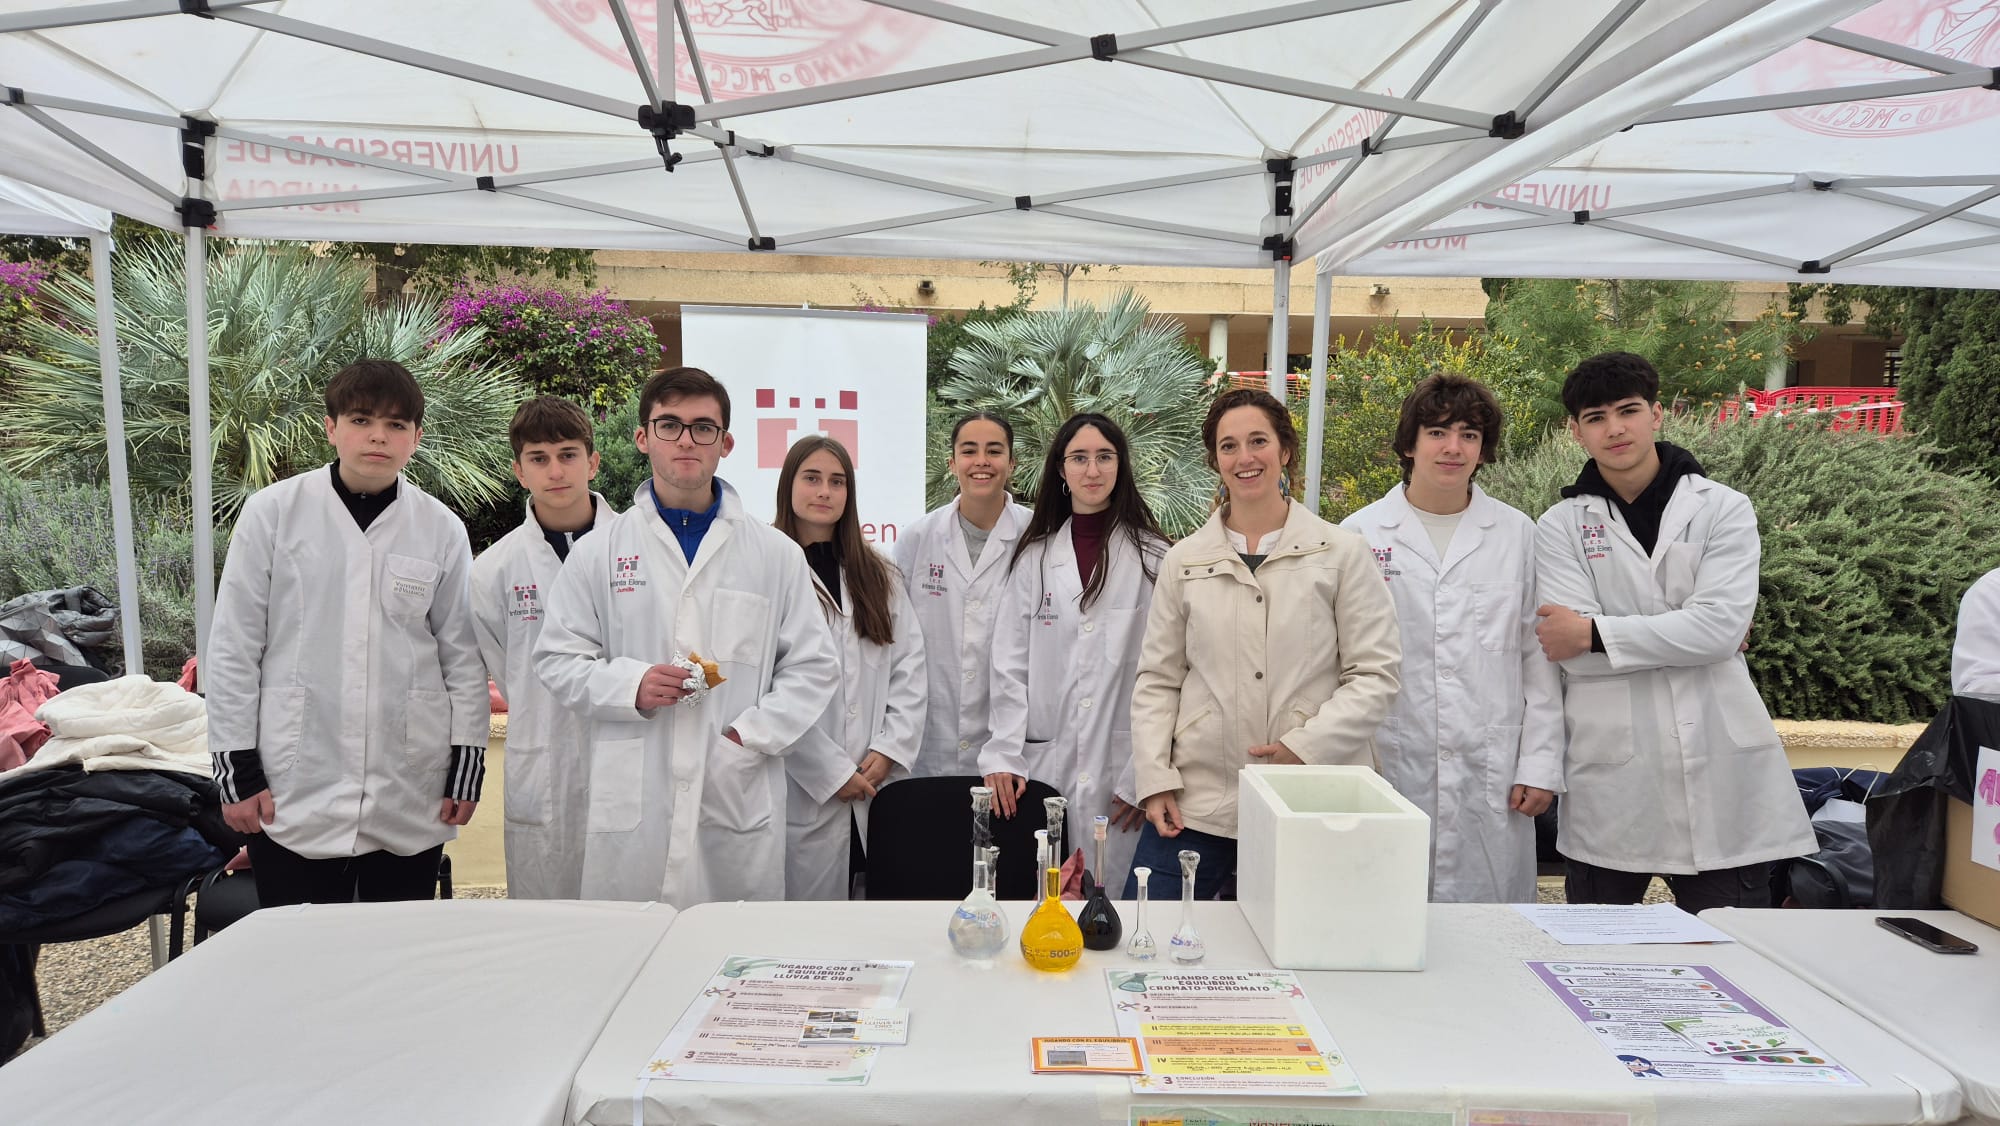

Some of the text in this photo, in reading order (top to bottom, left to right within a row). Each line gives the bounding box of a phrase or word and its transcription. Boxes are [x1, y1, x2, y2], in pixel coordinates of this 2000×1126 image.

[628, 578, 647, 586] Elena
[1050, 949, 1070, 958] 500
[776, 963, 825, 972] JUGANDO
[774, 973, 811, 981] LLUVIA
[685, 1051, 695, 1059] 3
[1163, 1076, 1173, 1085] 3
